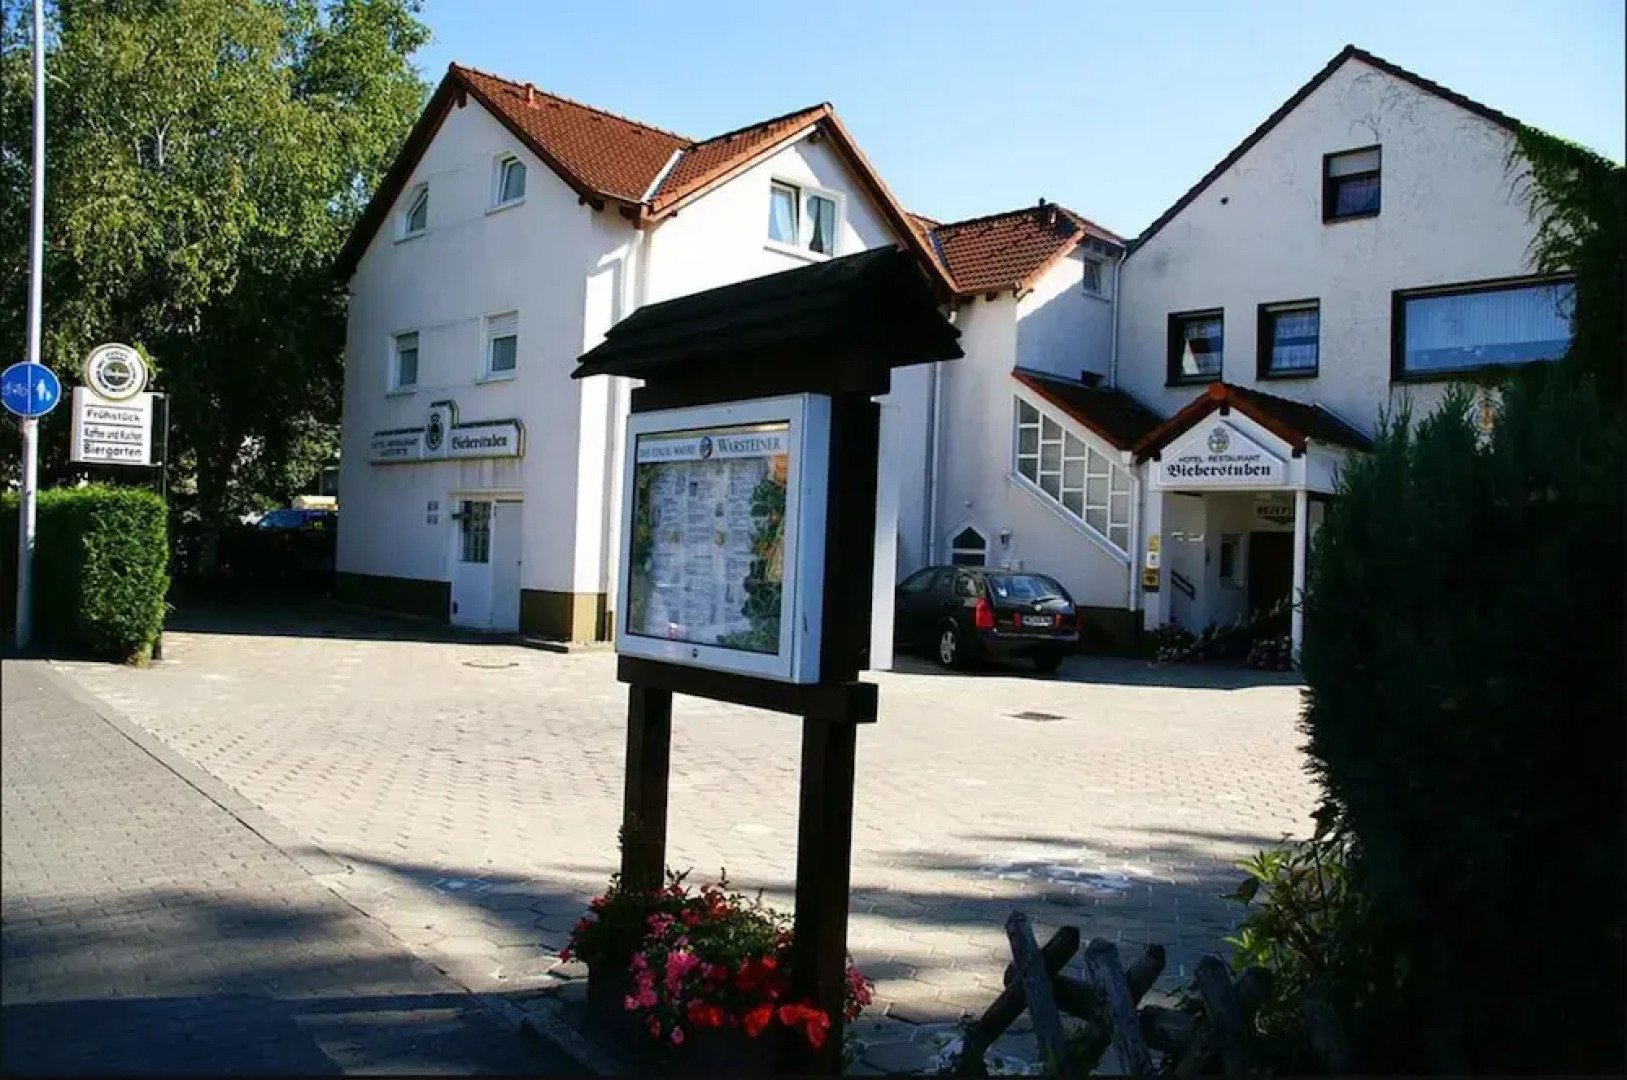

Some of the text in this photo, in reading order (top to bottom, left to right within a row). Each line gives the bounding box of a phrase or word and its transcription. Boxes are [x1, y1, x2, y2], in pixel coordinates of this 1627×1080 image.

[83, 442, 142, 459] Biergarten
[717, 437, 780, 453] WARSTEINER
[1167, 463, 1272, 478] Bieberstuben
